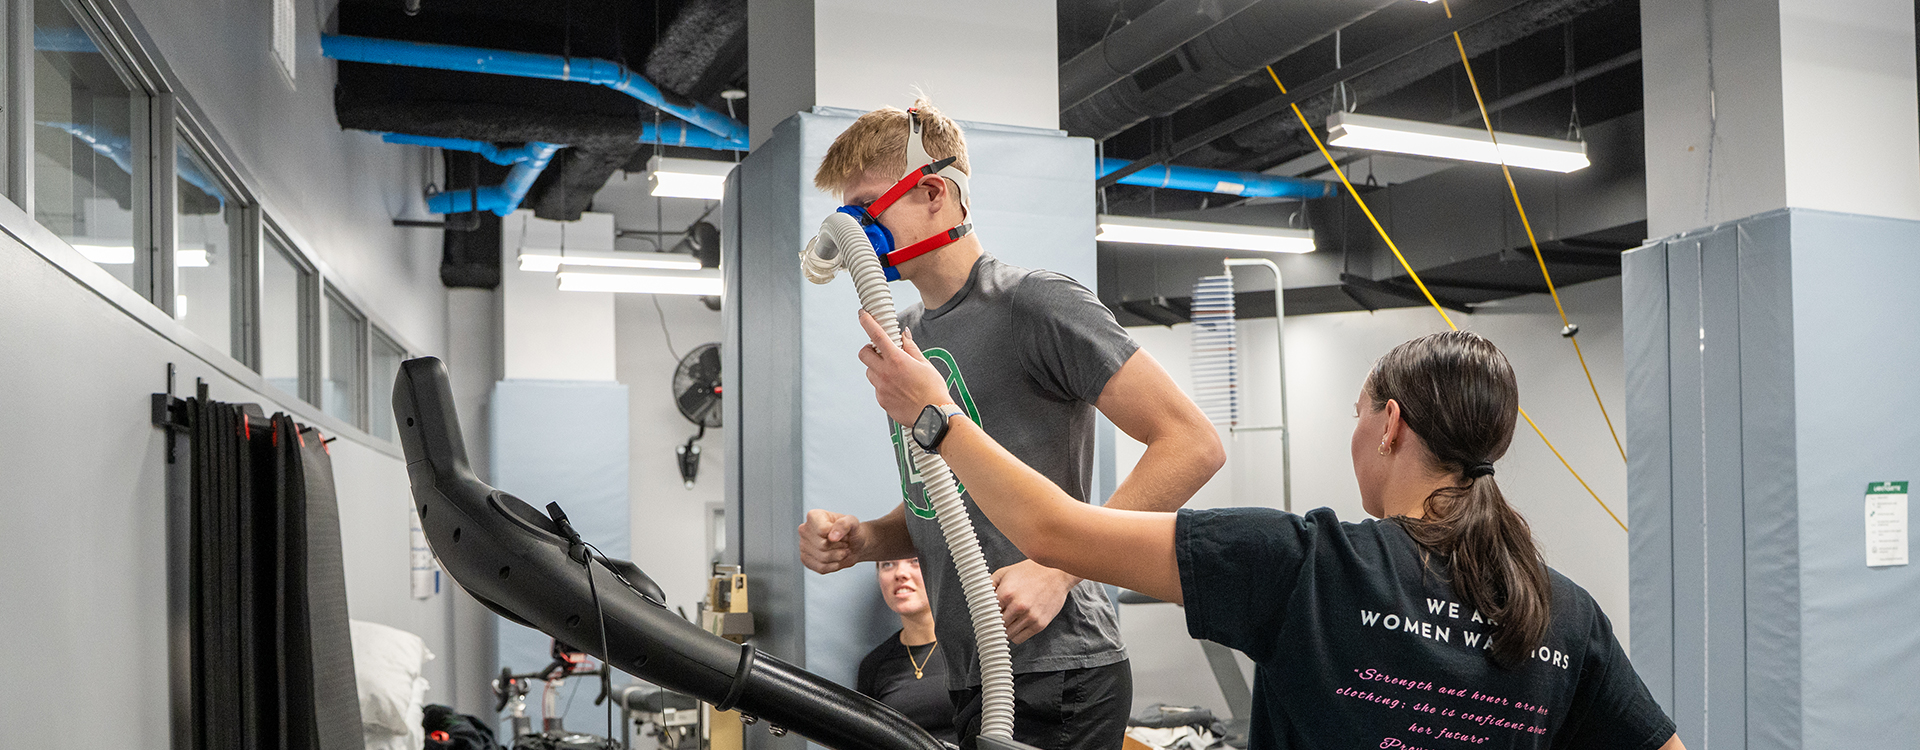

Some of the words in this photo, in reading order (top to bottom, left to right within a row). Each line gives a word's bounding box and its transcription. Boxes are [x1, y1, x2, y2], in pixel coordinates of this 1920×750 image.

[1426, 598, 1460, 619] WE
[1361, 609, 1450, 643] WOMEN
[1463, 630, 1570, 670] WAIORS
[1438, 686, 1467, 697] and
[1471, 691, 1509, 706] honor
[1514, 701, 1535, 712] are
[1408, 722, 1433, 735] her
[1413, 703, 1437, 714] she
[1441, 708, 1456, 717] is
[1461, 713, 1525, 731] confident
